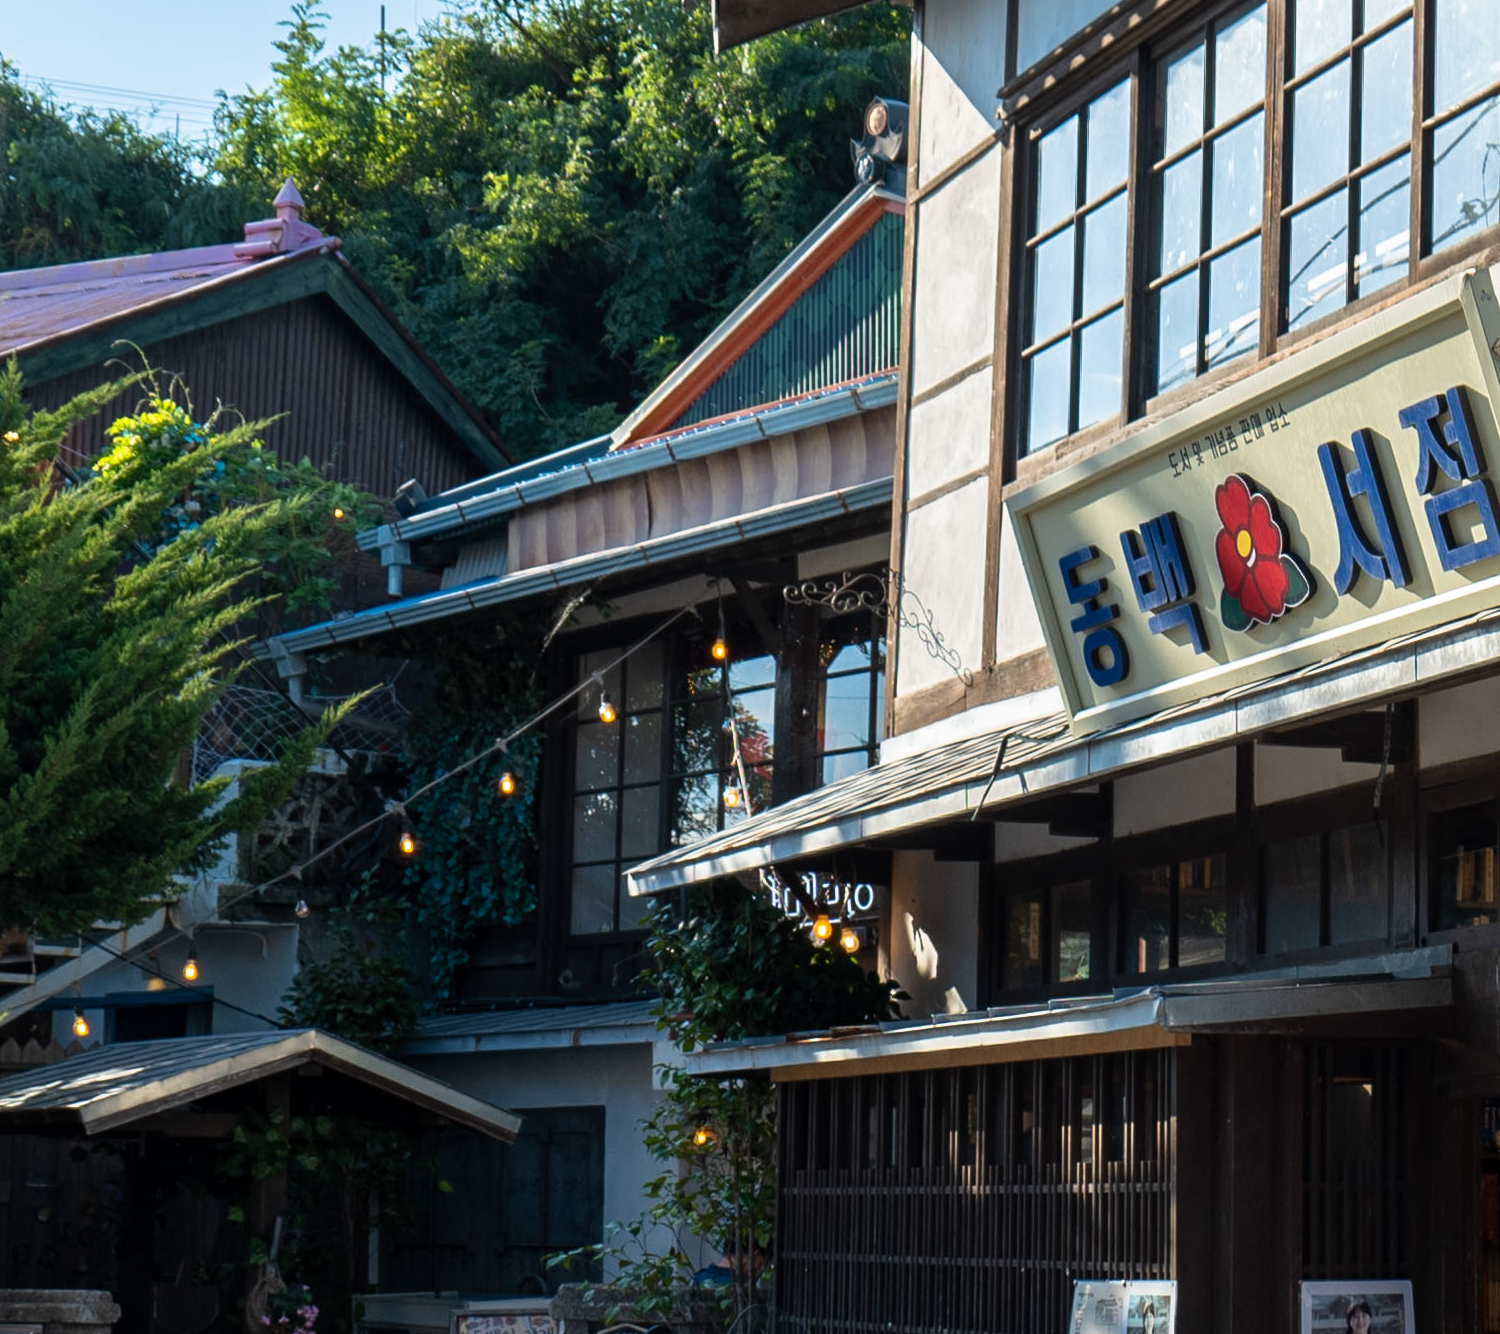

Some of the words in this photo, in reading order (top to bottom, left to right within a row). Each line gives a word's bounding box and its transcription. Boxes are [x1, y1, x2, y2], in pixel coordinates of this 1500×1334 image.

[1168, 447, 1192, 478] 도서
[1191, 441, 1204, 466] 및
[1205, 425, 1238, 459] 기념품
[1238, 412, 1265, 444] 판매
[1265, 402, 1291, 432] 업소
[1058, 512, 1208, 687] 동백
